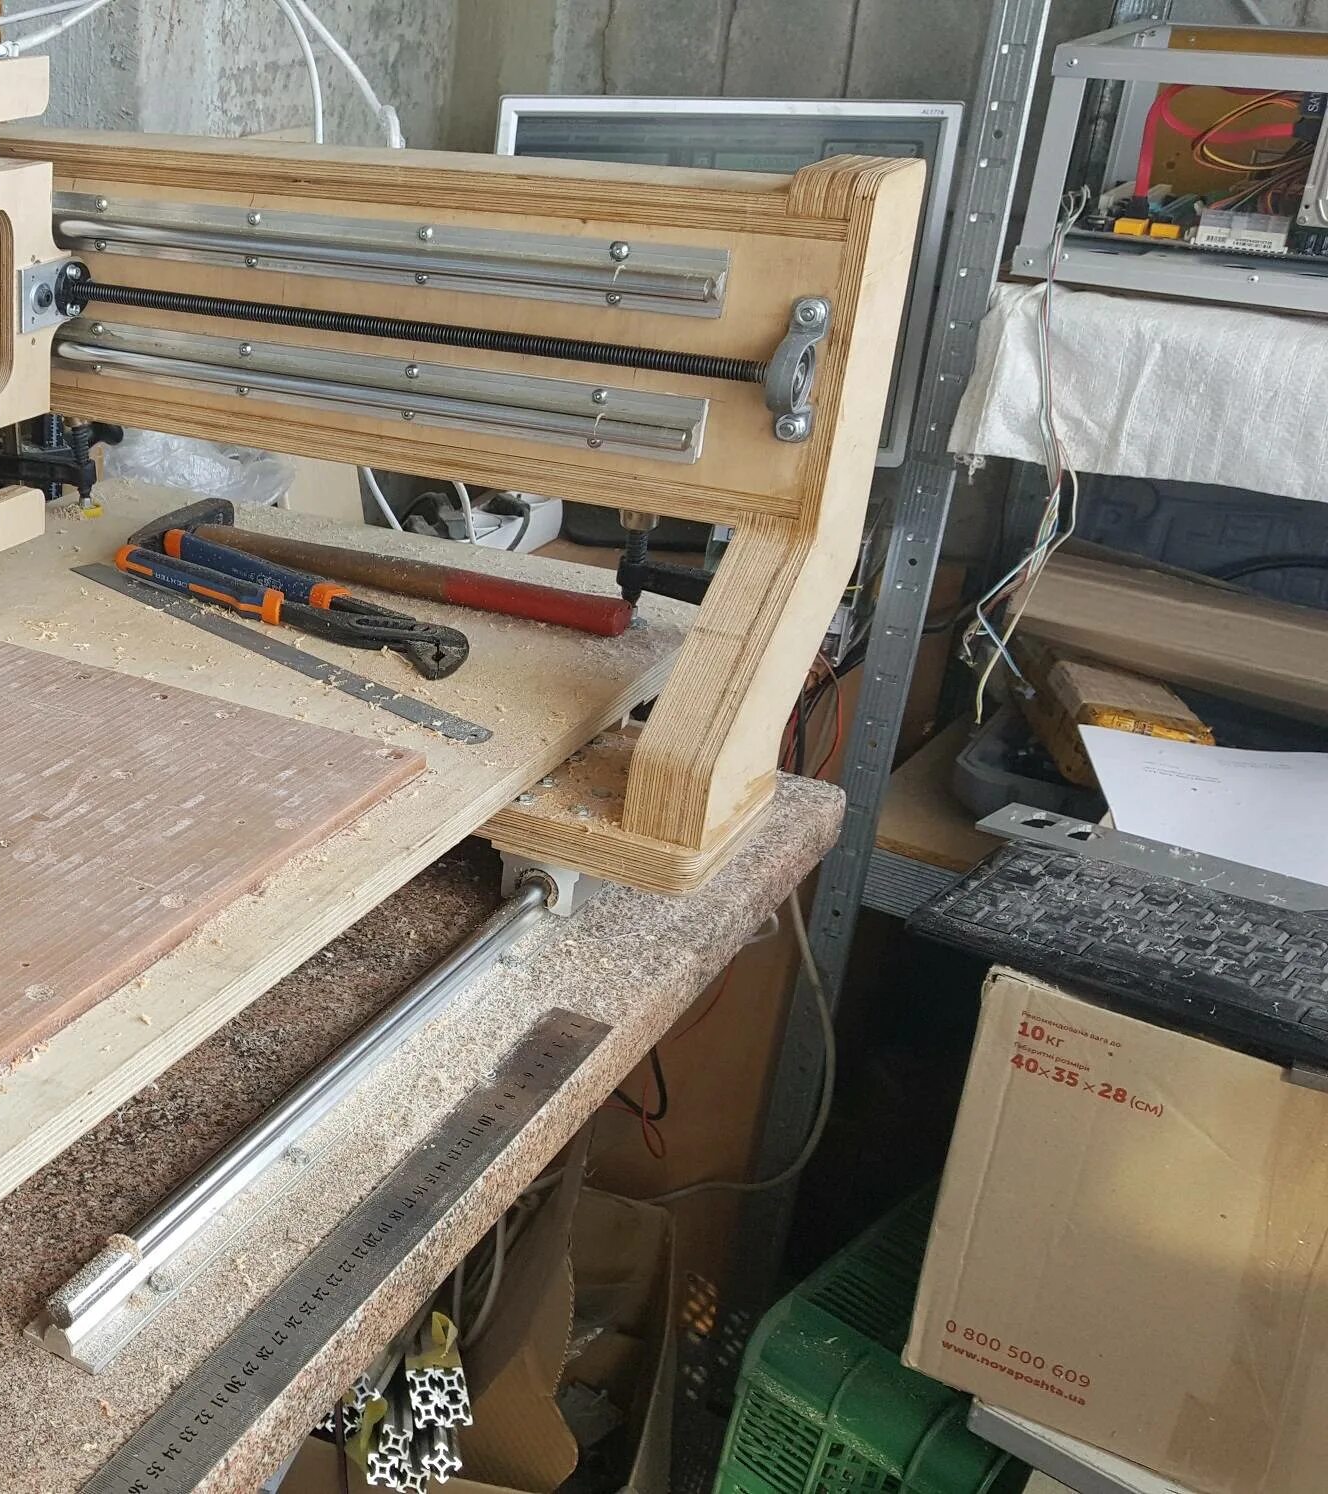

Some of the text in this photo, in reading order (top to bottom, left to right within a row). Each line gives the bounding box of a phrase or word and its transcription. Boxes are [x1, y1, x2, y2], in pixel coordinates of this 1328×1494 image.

[1018, 1021, 1045, 1041] 10
[477, 1114, 496, 1127] 10
[469, 1126, 484, 1137] 11
[457, 1138, 472, 1149] 12
[447, 1149, 462, 1161] 13
[435, 1161, 451, 1173] 14
[425, 1173, 440, 1184] 15
[413, 1185, 429, 1196] 16
[401, 1197, 417, 1209] 17
[389, 1210, 405, 1222] 18
[378, 1222, 393, 1234] 19
[363, 1231, 383, 1248] 20
[352, 1246, 369, 1260] 21
[338, 1259, 356, 1273] 22
[325, 1273, 343, 1287] 23
[312, 1287, 330, 1301] 24
[298, 1301, 317, 1316] 25
[284, 1315, 303, 1330] 26
[272, 1330, 289, 1346] 27
[255, 1345, 274, 1361] 28
[945, 1320, 1091, 1388] 0 800 500 609
[242, 1360, 260, 1377] 29
[941, 1340, 1086, 1406] www.novaposhta.ua
[224, 1375, 247, 1394] 30
[210, 1392, 230, 1408] 31
[194, 1408, 215, 1425] 32
[179, 1425, 199, 1443] 33
[162, 1442, 182, 1460] 34
[146, 1461, 166, 1479] 35
[128, 1479, 149, 1494] 36
